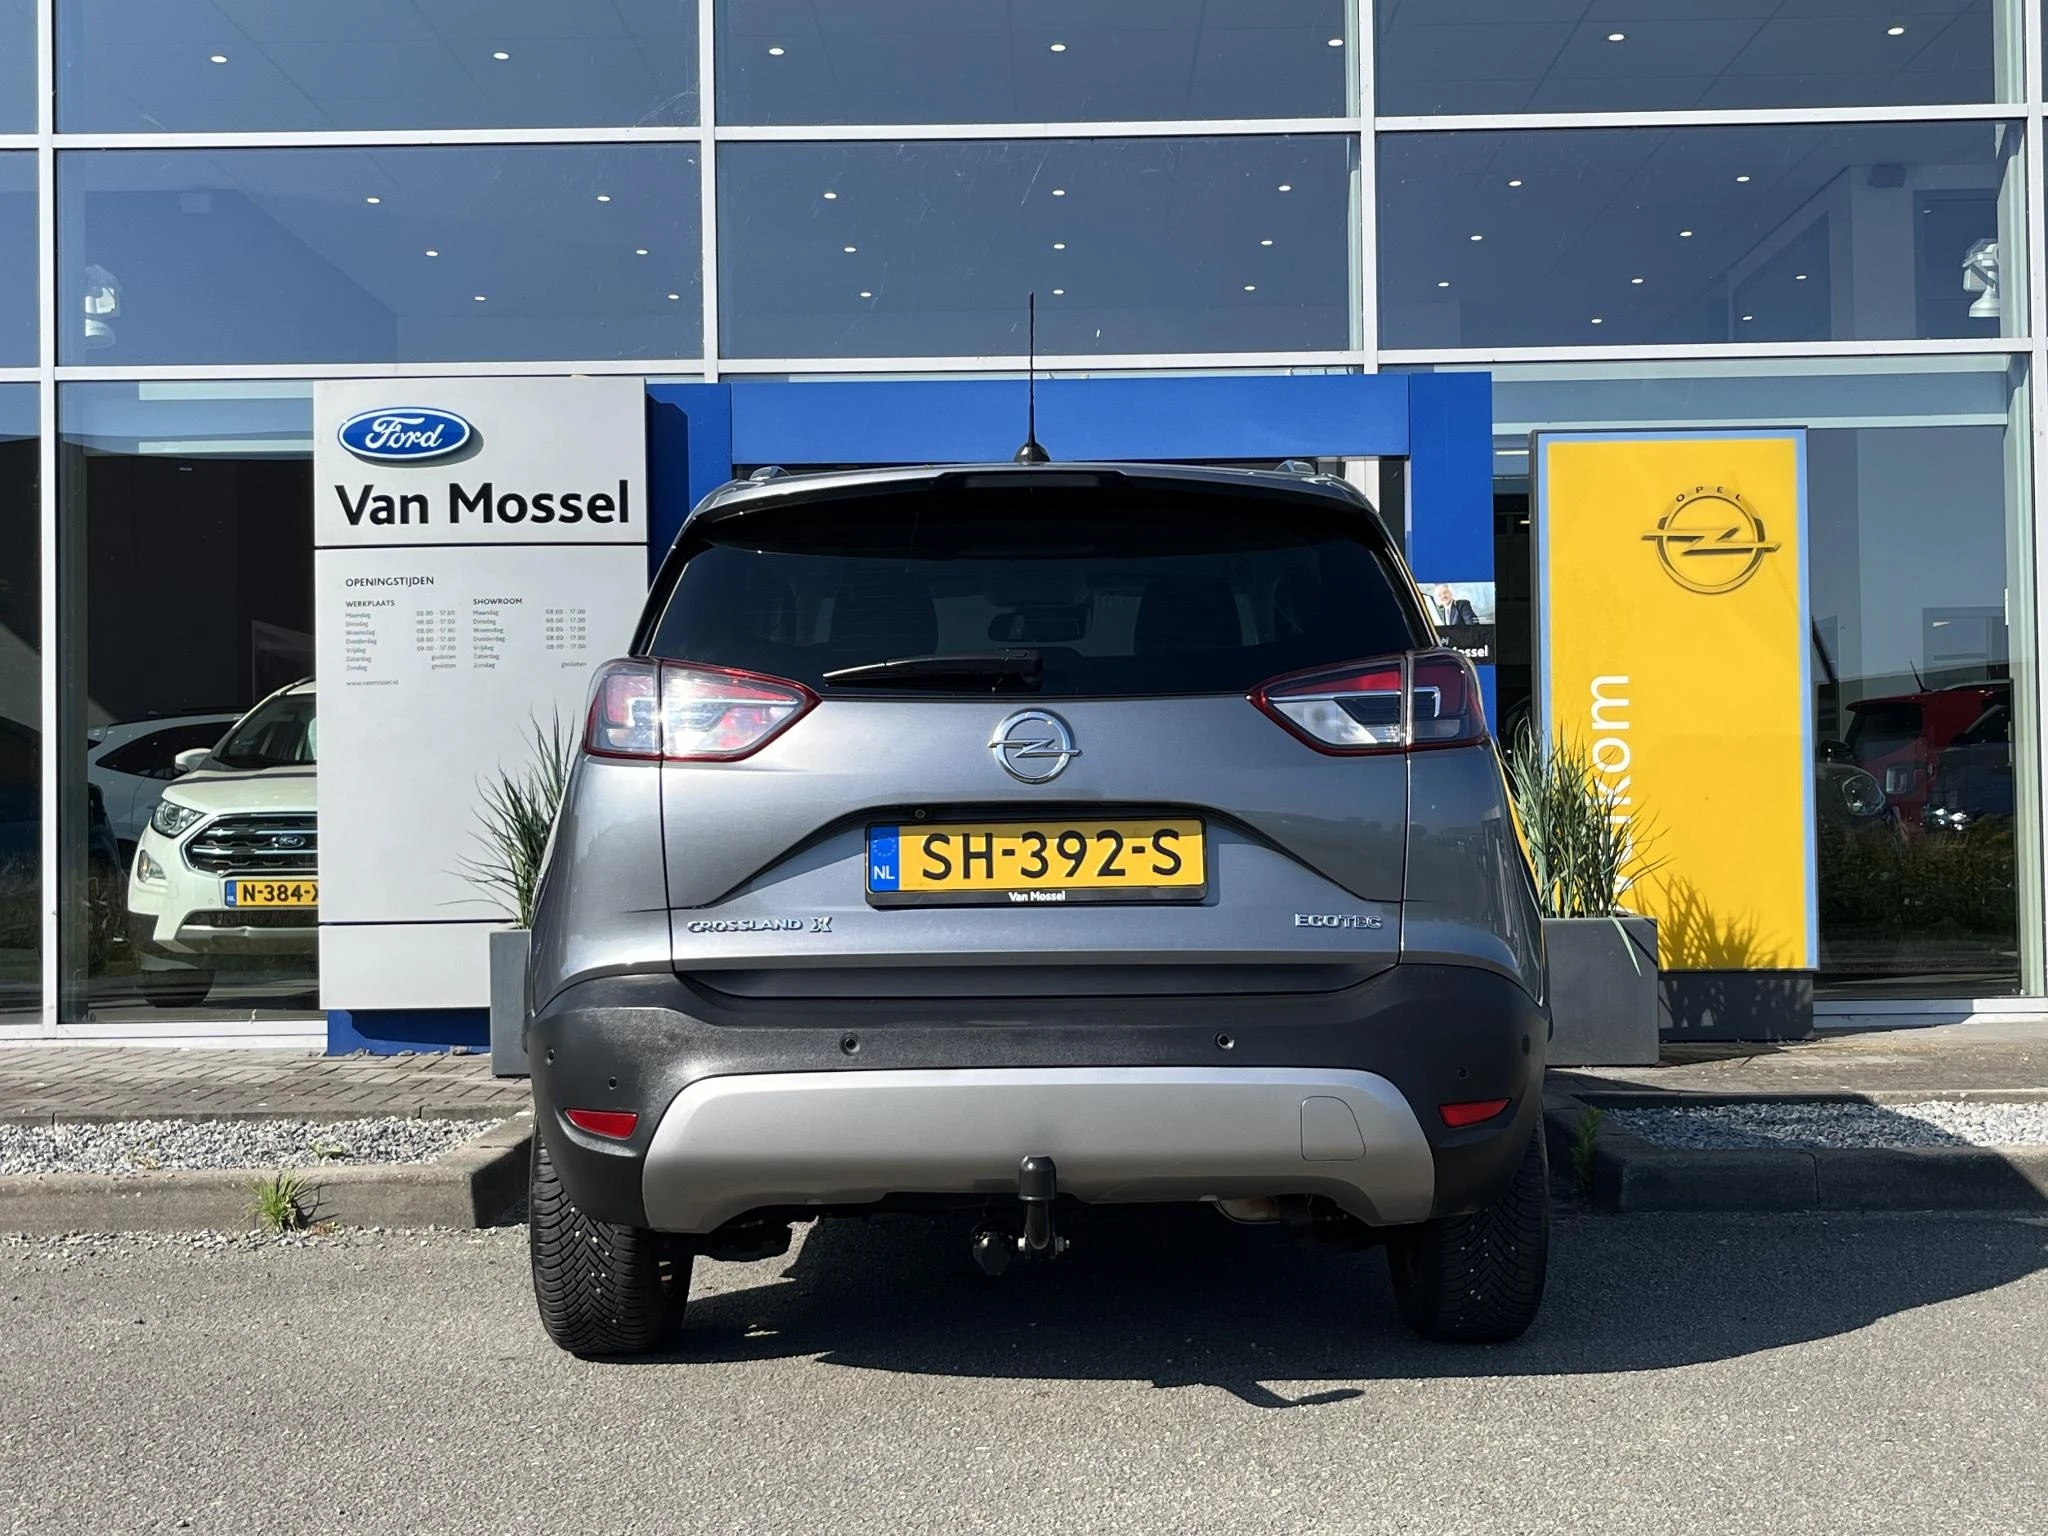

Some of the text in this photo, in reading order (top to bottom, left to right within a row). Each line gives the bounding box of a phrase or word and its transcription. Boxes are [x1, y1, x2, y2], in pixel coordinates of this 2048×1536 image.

[364, 415, 445, 449] Ford
[1676, 486, 1741, 502] OPEL
[334, 479, 629, 526] Van Mossel
[345, 576, 434, 587] OPENINGSTIJDEN
[922, 829, 1182, 881] SH-392-S
[873, 865, 895, 880] NL
[1008, 890, 1066, 902] Van Mossel
[687, 917, 833, 933] CROSSLAND X
[1295, 913, 1382, 928] ECOTEC
